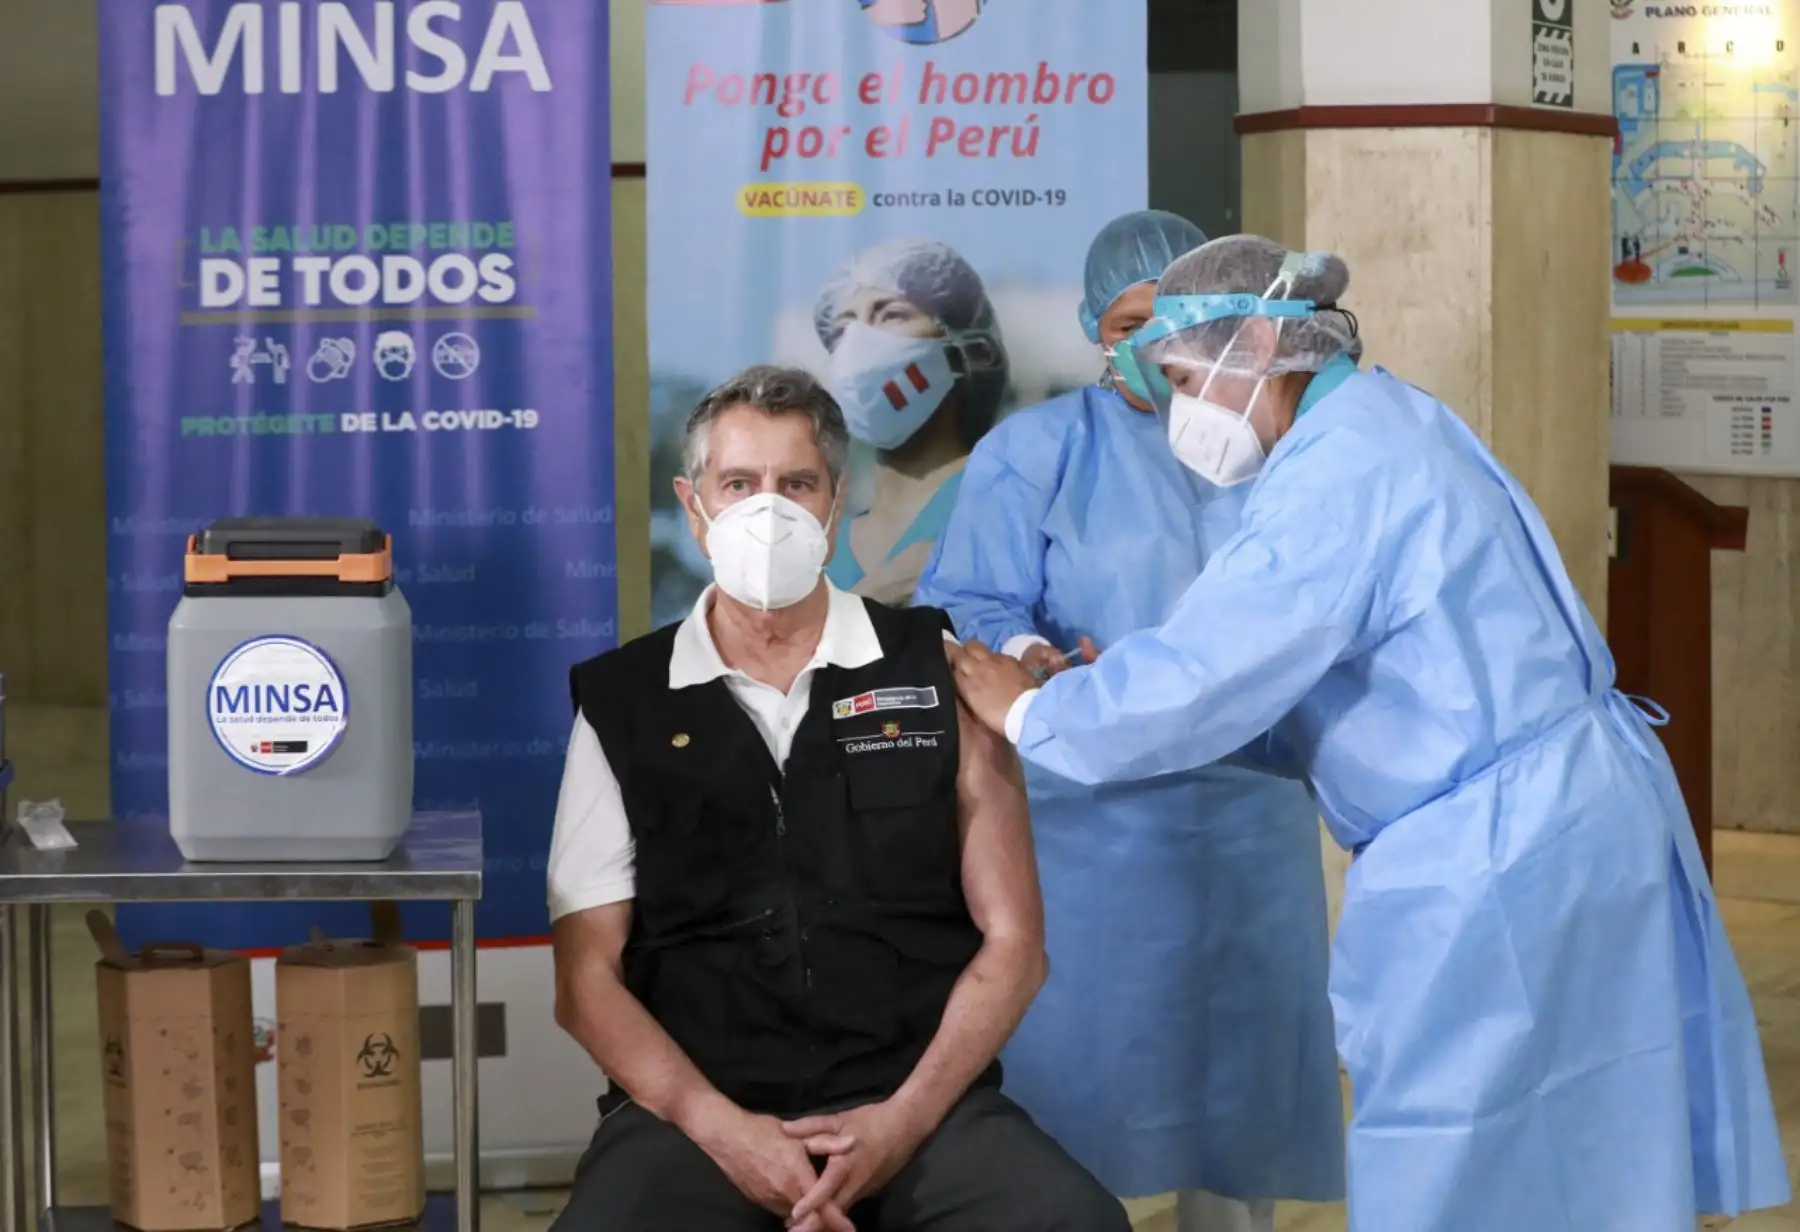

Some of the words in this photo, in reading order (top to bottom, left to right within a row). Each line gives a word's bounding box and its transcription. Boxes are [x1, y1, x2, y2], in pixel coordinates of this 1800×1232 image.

[1645, 5, 1697, 18] PLANO
[154, 1, 553, 95] MINSA
[1632, 41, 1640, 54] A
[682, 61, 839, 118] Pongo
[857, 61, 904, 105] el
[918, 61, 1116, 105] hombro
[760, 123, 852, 172] por
[864, 115, 910, 159] el
[925, 114, 1041, 159] Perú
[744, 187, 858, 209] VACÚNATE
[871, 191, 942, 208] contra
[946, 189, 966, 208] la
[972, 189, 1067, 208] COVID-19
[201, 226, 241, 253] LA
[251, 224, 357, 252] SALUD
[366, 221, 515, 250] DEPENDE
[201, 257, 281, 307] DE
[294, 253, 516, 304] TODOS
[181, 411, 336, 437] PROTÉGETE
[342, 413, 377, 432] DE
[383, 411, 417, 432] LA
[422, 409, 540, 431] COVID-19
[408, 506, 517, 526] Ministerio
[521, 505, 547, 525] de
[553, 503, 613, 525] Salud
[416, 563, 476, 583] Salud
[524, 620, 549, 639] de
[556, 617, 614, 639] Salud
[216, 684, 338, 713] MINSA
[418, 677, 477, 698] Salud
[216, 715, 228, 723] La
[230, 715, 254, 723] salud
[256, 715, 297, 724] depende
[300, 714, 311, 722] de
[314, 714, 339, 722] todos
[846, 739, 895, 753] Gobierno
[898, 737, 912, 748] del
